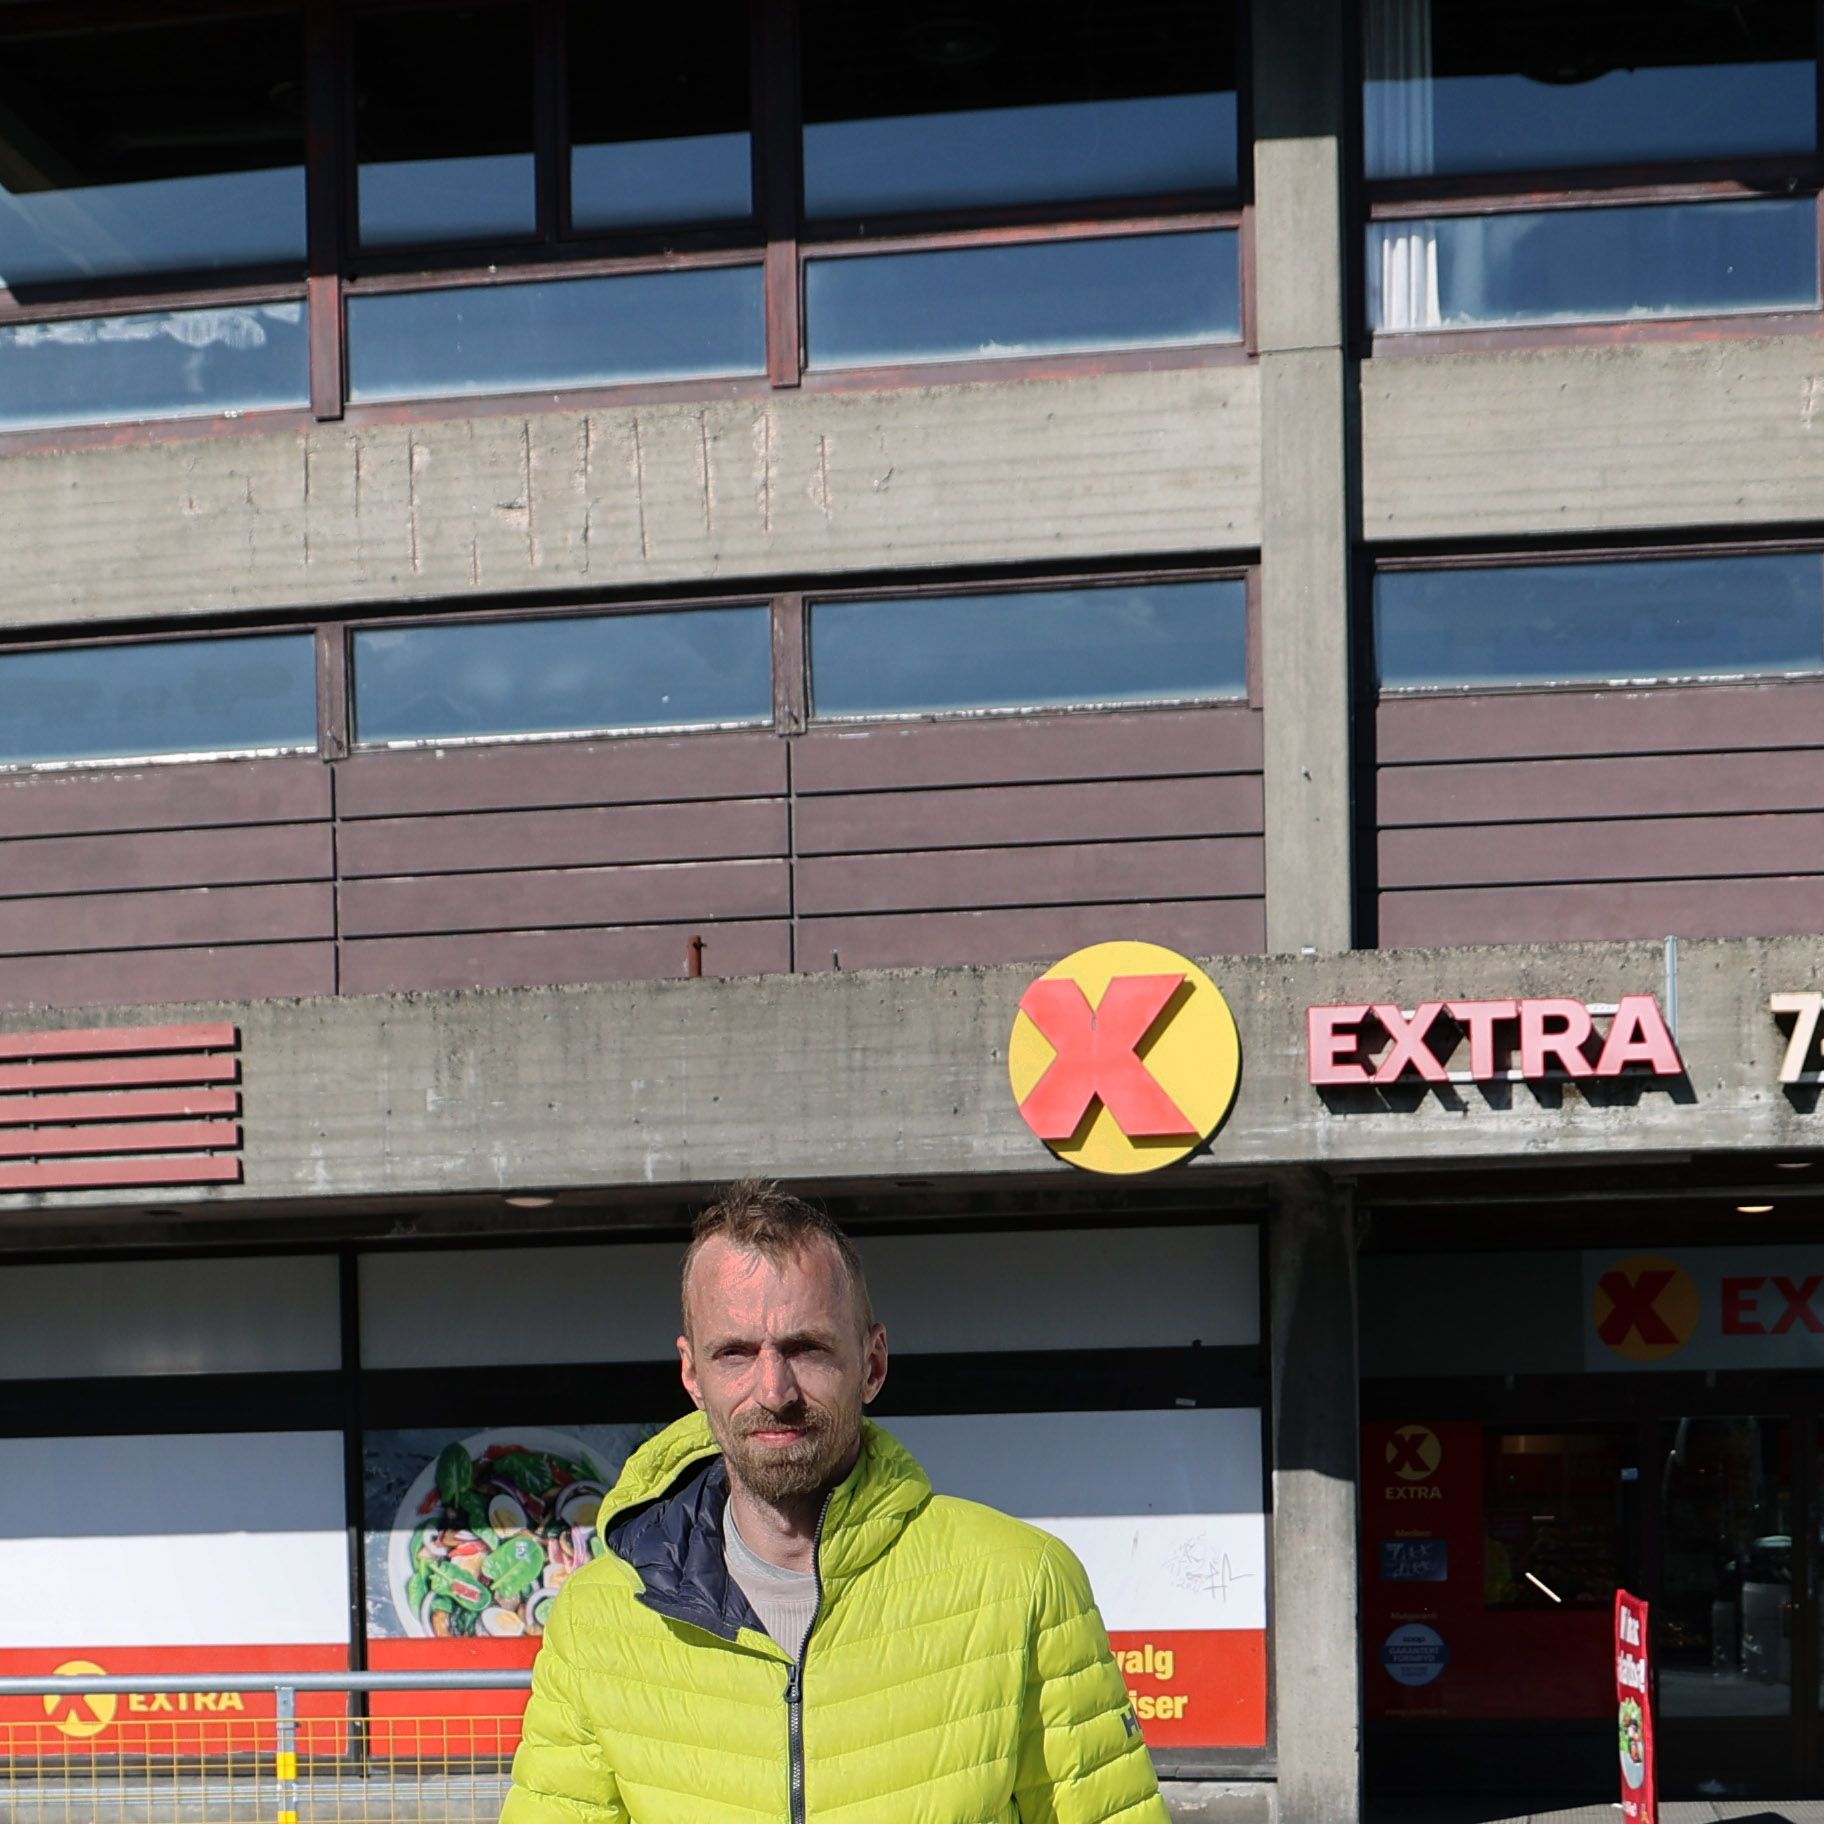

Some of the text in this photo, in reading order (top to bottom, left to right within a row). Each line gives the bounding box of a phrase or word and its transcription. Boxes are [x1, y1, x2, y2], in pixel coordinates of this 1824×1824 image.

[1308, 994, 1682, 1085] EXTRA
[1384, 1486, 1443, 1501] EXTRA
[128, 1691, 245, 1714] EXTRA
